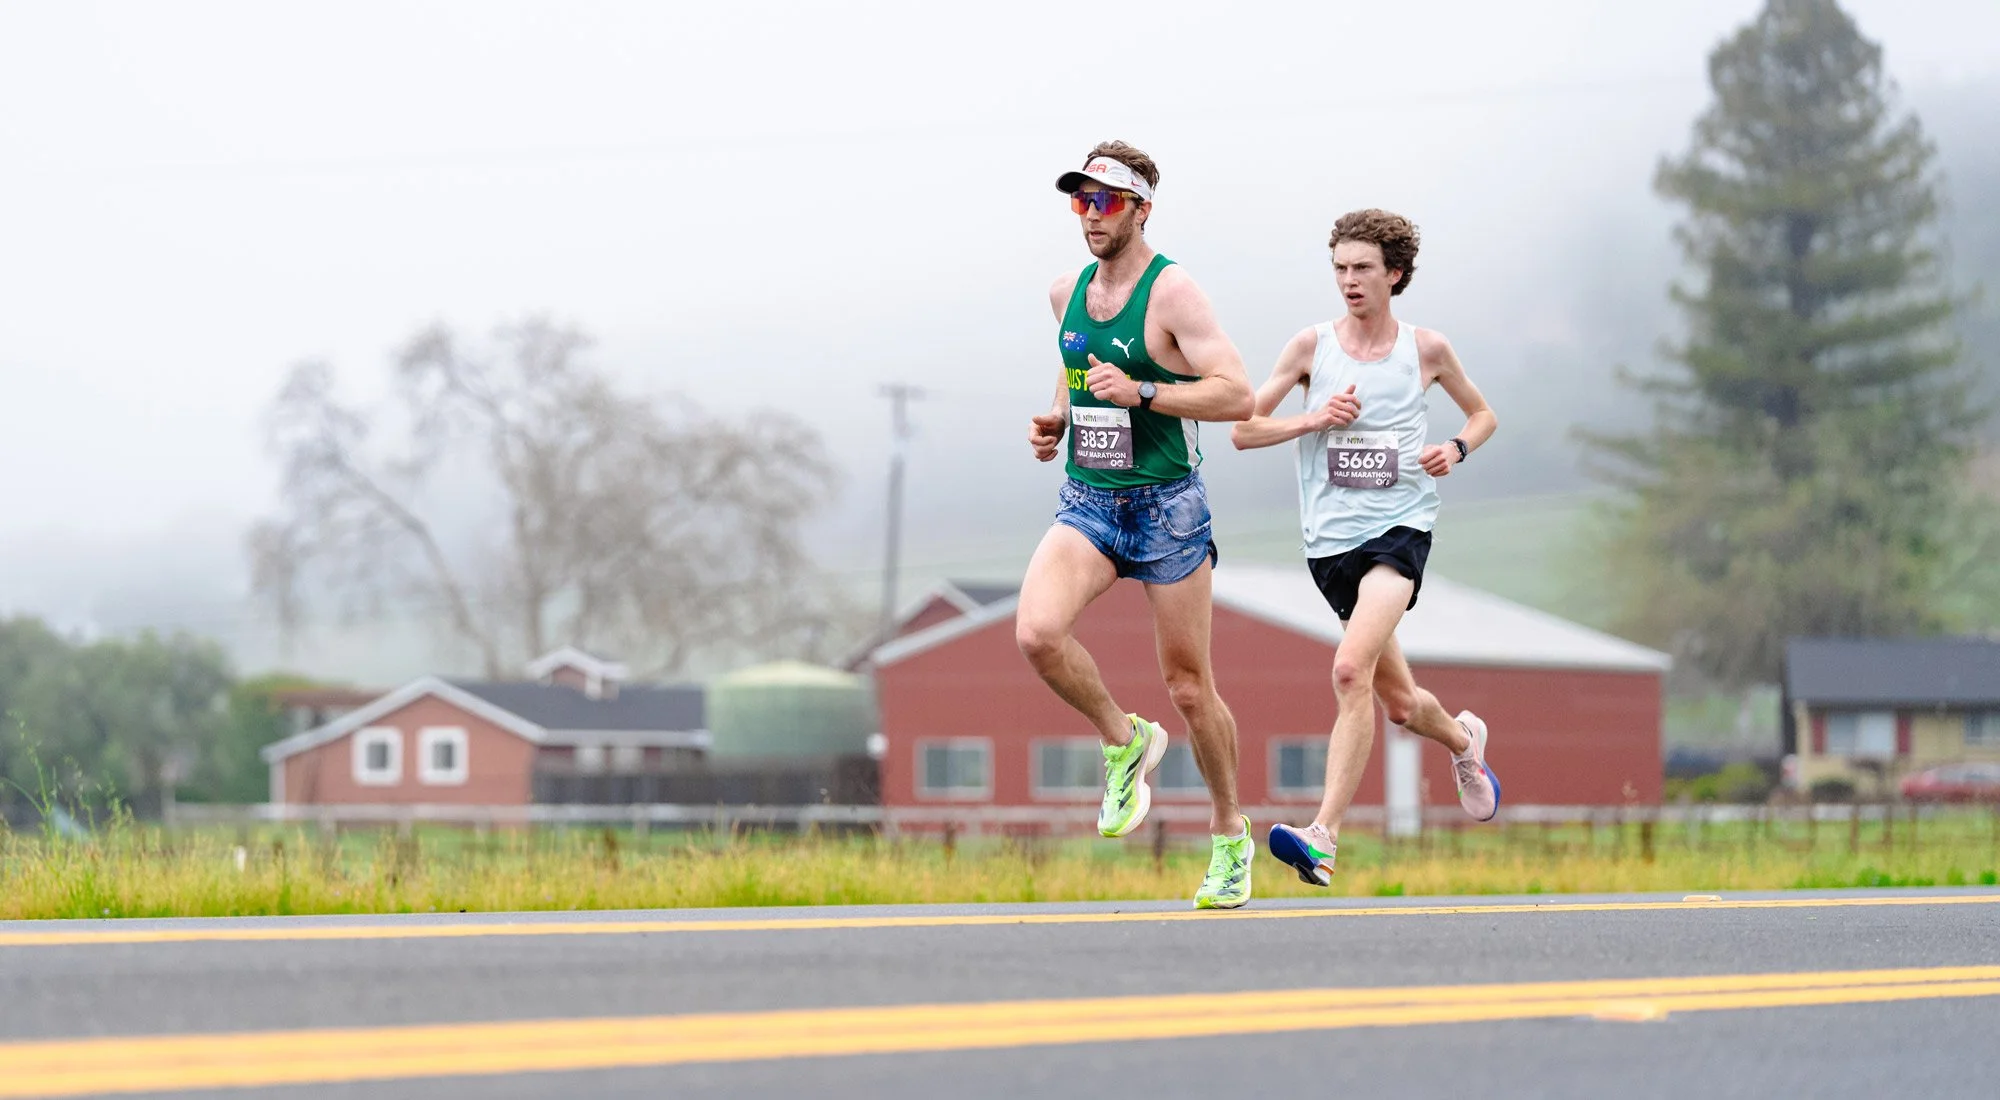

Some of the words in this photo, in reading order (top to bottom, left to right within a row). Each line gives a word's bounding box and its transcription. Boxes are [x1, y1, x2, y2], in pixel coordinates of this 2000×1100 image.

[1080, 429, 1120, 449] 3837
[1089, 451, 1127, 459] MARATHON
[1338, 452, 1387, 469] 5669
